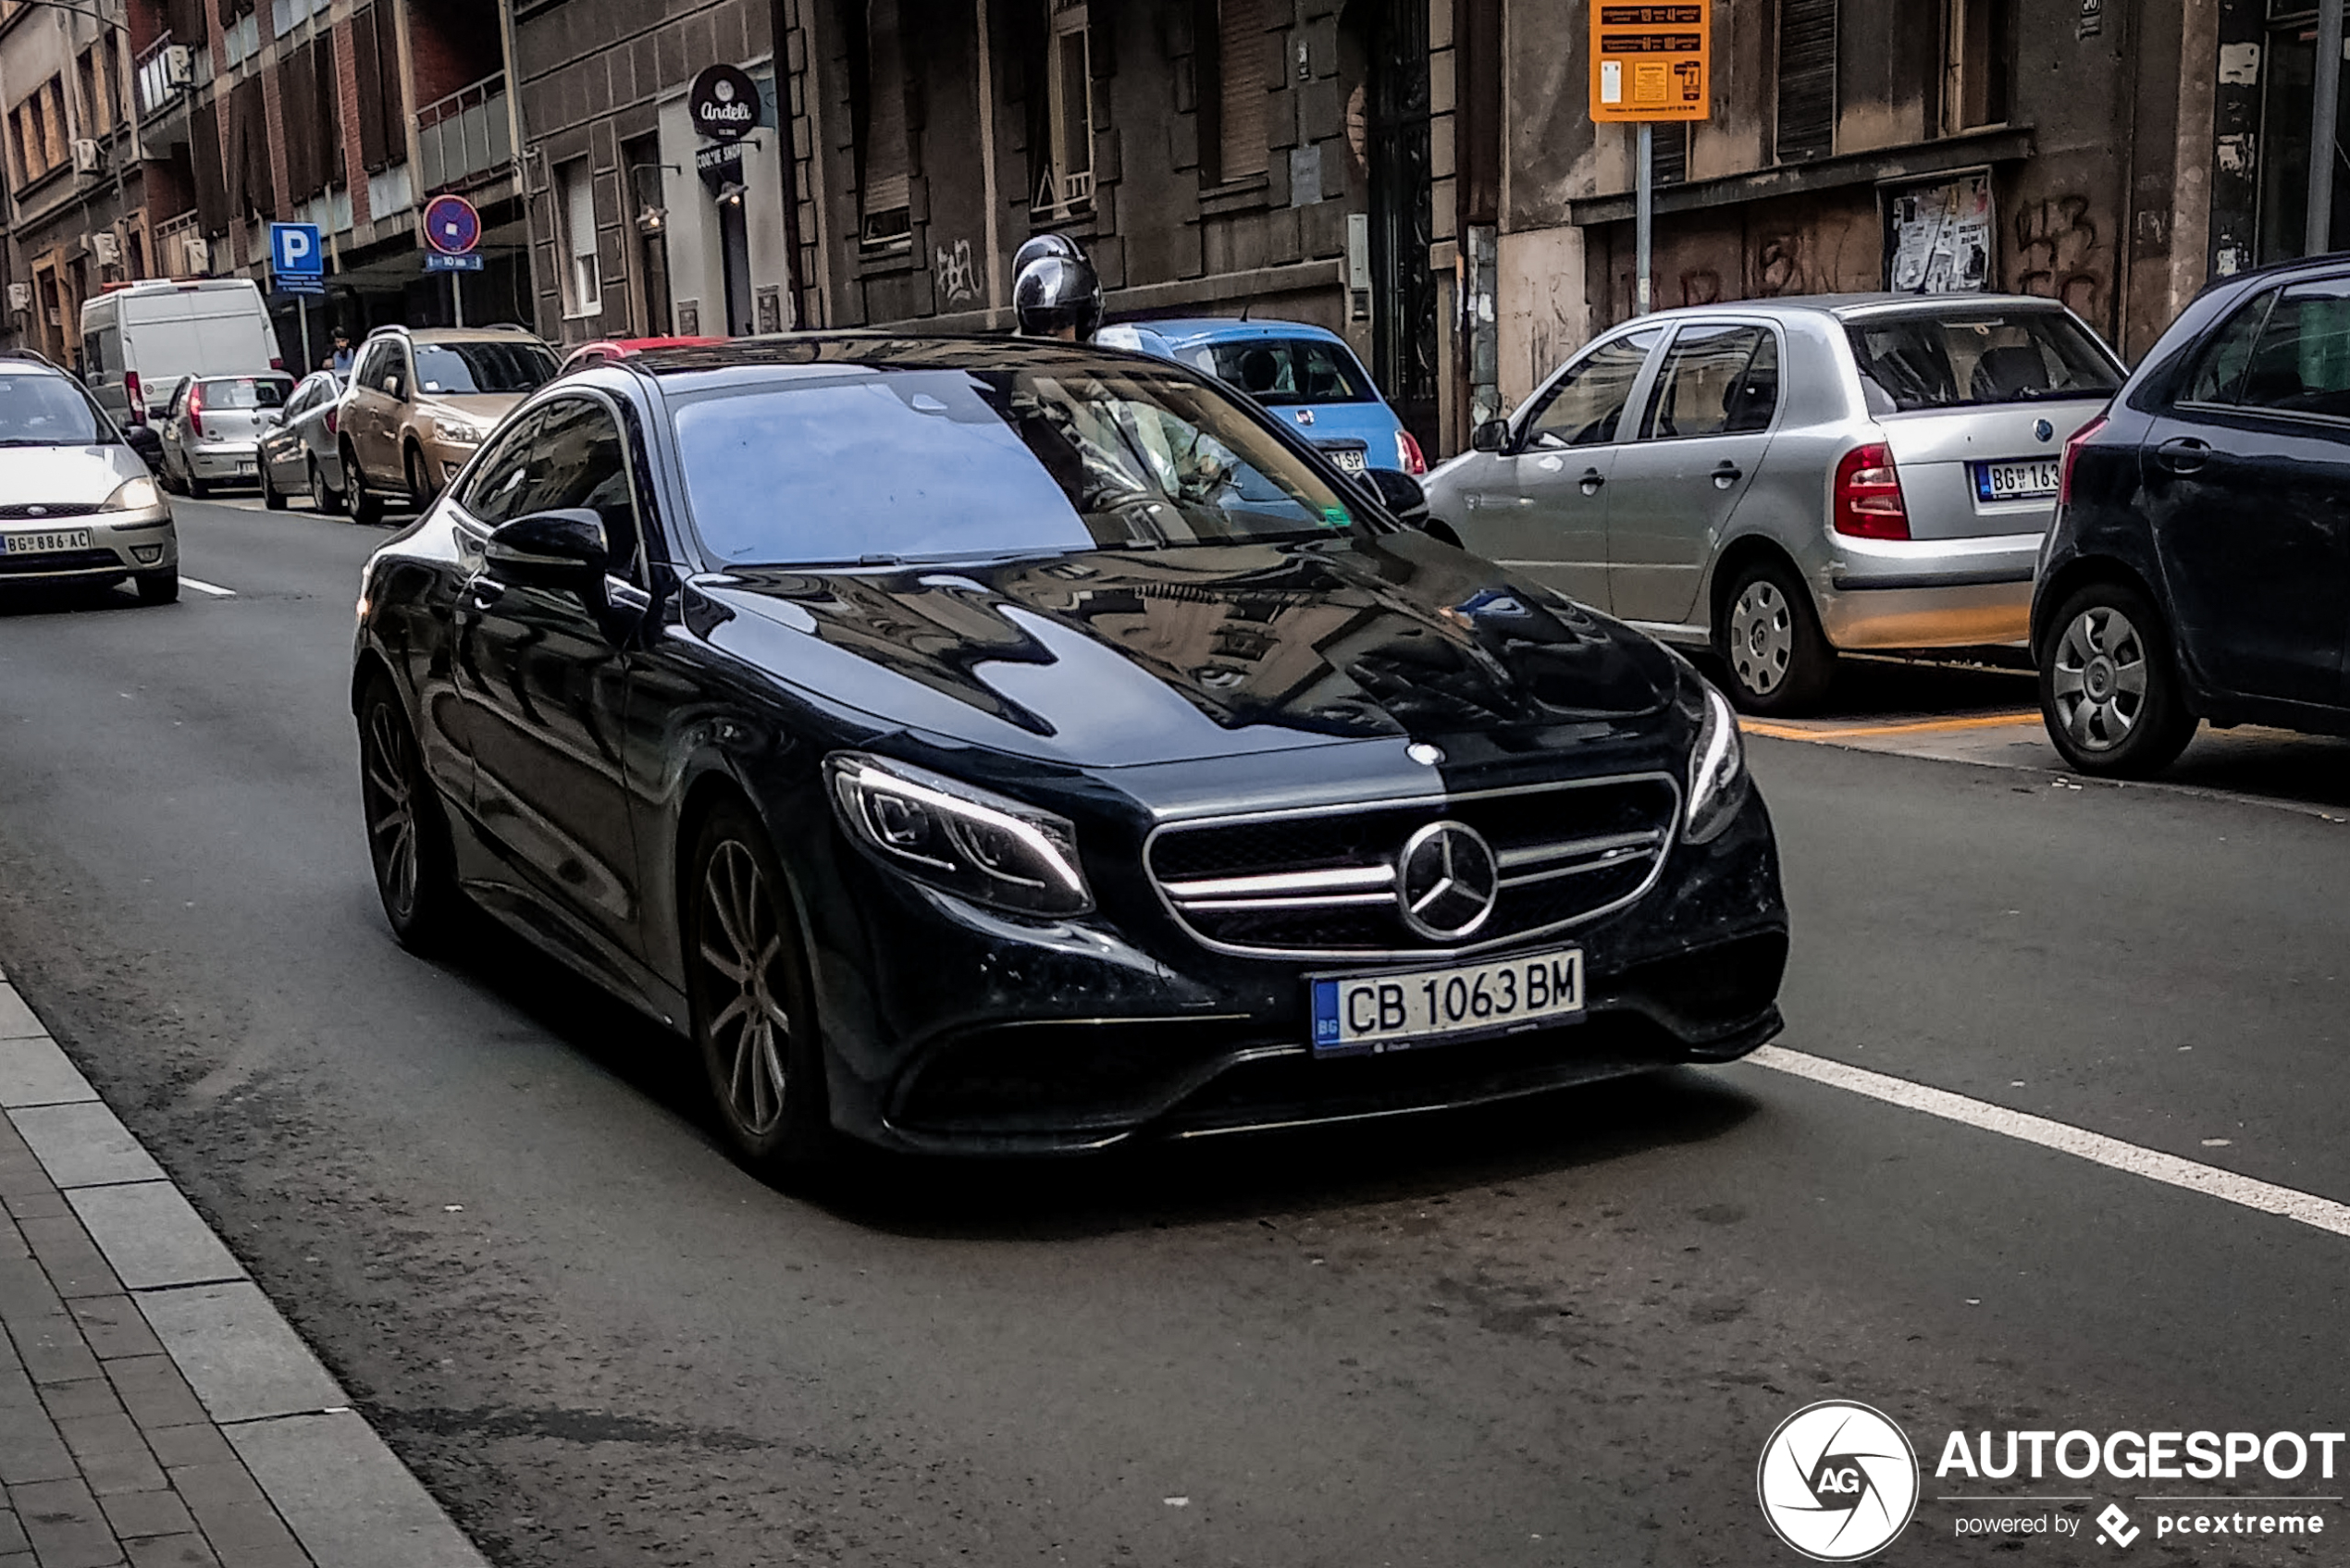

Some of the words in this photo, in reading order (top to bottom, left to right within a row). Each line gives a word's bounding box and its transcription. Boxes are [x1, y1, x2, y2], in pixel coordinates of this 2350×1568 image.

[281, 229, 310, 268] P
[443, 255, 454, 267] 10
[1992, 467, 2015, 491] BG
[2030, 463, 2059, 488] 163
[7, 537, 27, 552] BG
[1347, 983, 1406, 1033] CB
[1422, 969, 1517, 1025] 1063
[1527, 957, 1576, 1010] BM
[1318, 1019, 1338, 1035] BG
